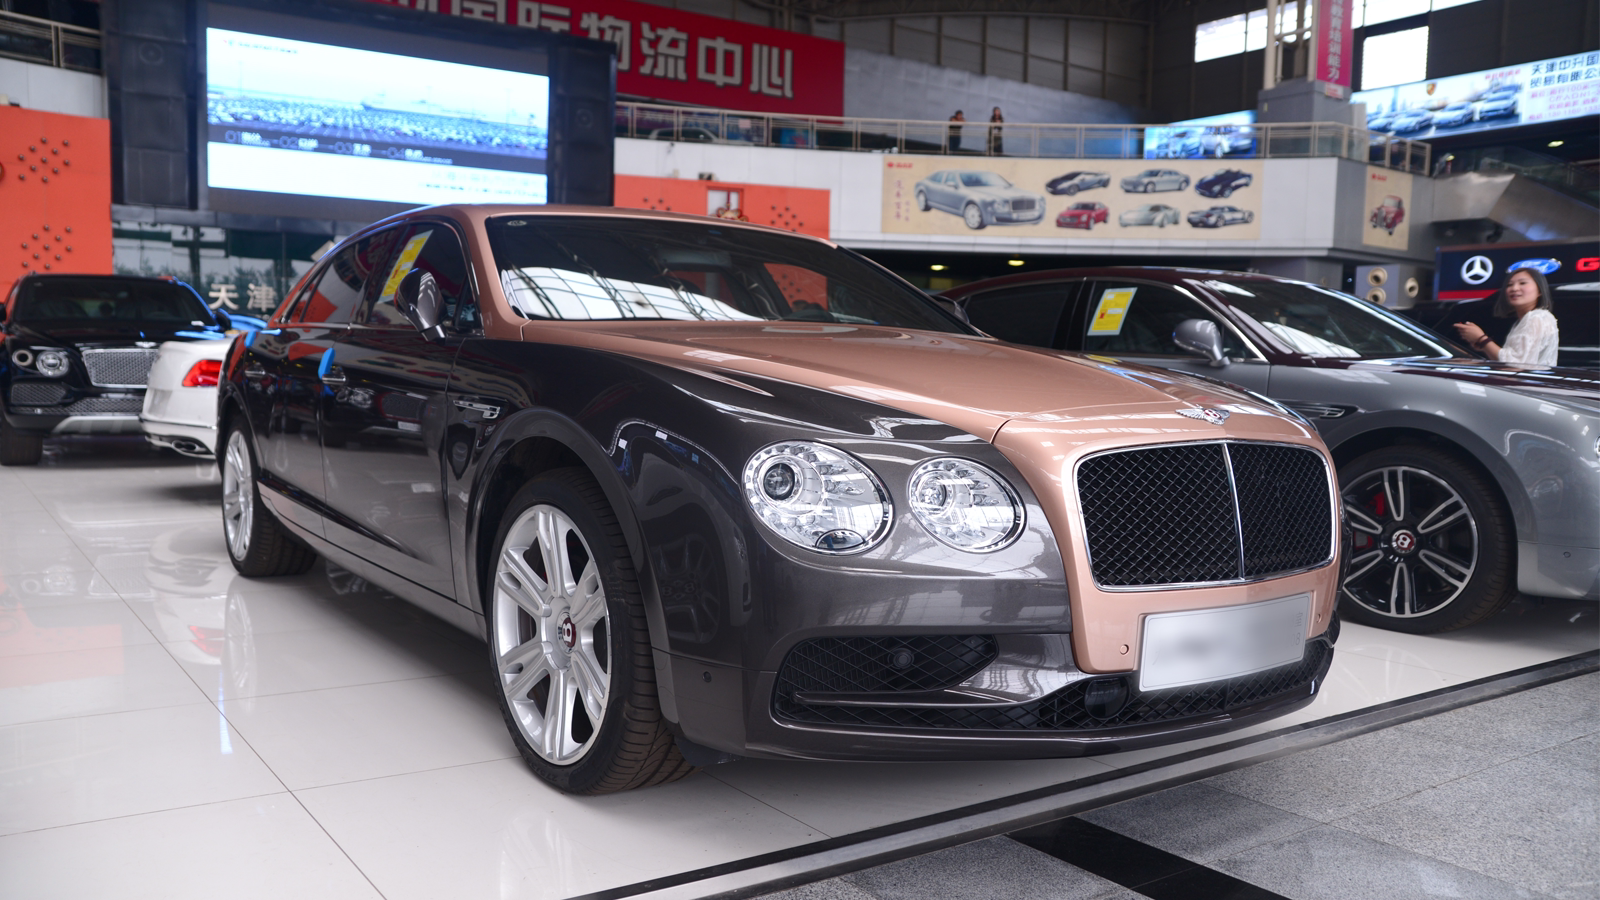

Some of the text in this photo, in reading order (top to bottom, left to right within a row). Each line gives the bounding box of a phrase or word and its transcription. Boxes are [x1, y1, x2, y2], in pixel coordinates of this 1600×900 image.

[395, 0, 794, 99] 国际物流中心
[1530, 67, 1600, 89] 贸易有限公
[208, 283, 277, 312] 天津
